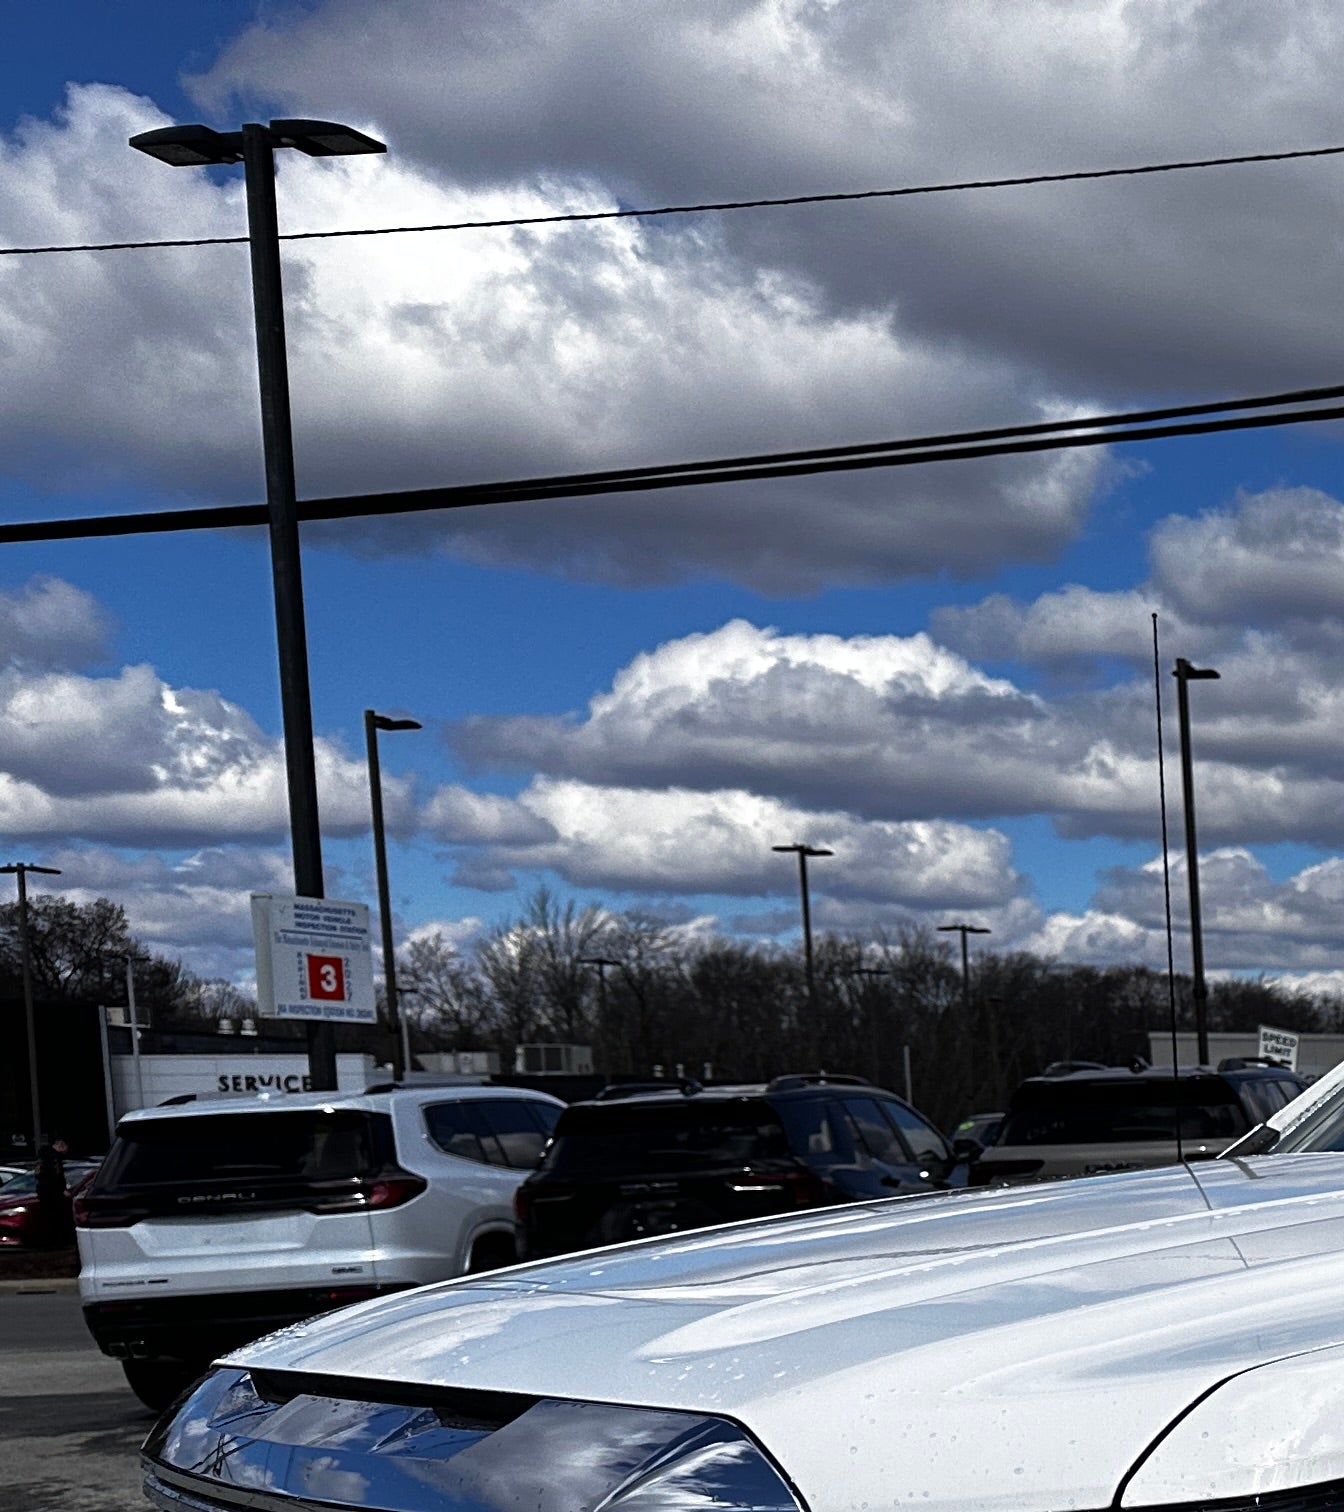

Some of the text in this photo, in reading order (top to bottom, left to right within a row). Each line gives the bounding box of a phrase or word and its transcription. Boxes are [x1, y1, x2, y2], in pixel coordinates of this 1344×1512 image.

[320, 964, 337, 993] 3
[1262, 1031, 1297, 1048] SPEED
[1264, 1043, 1291, 1057] LIMIT
[218, 1074, 312, 1093] SERVICE
